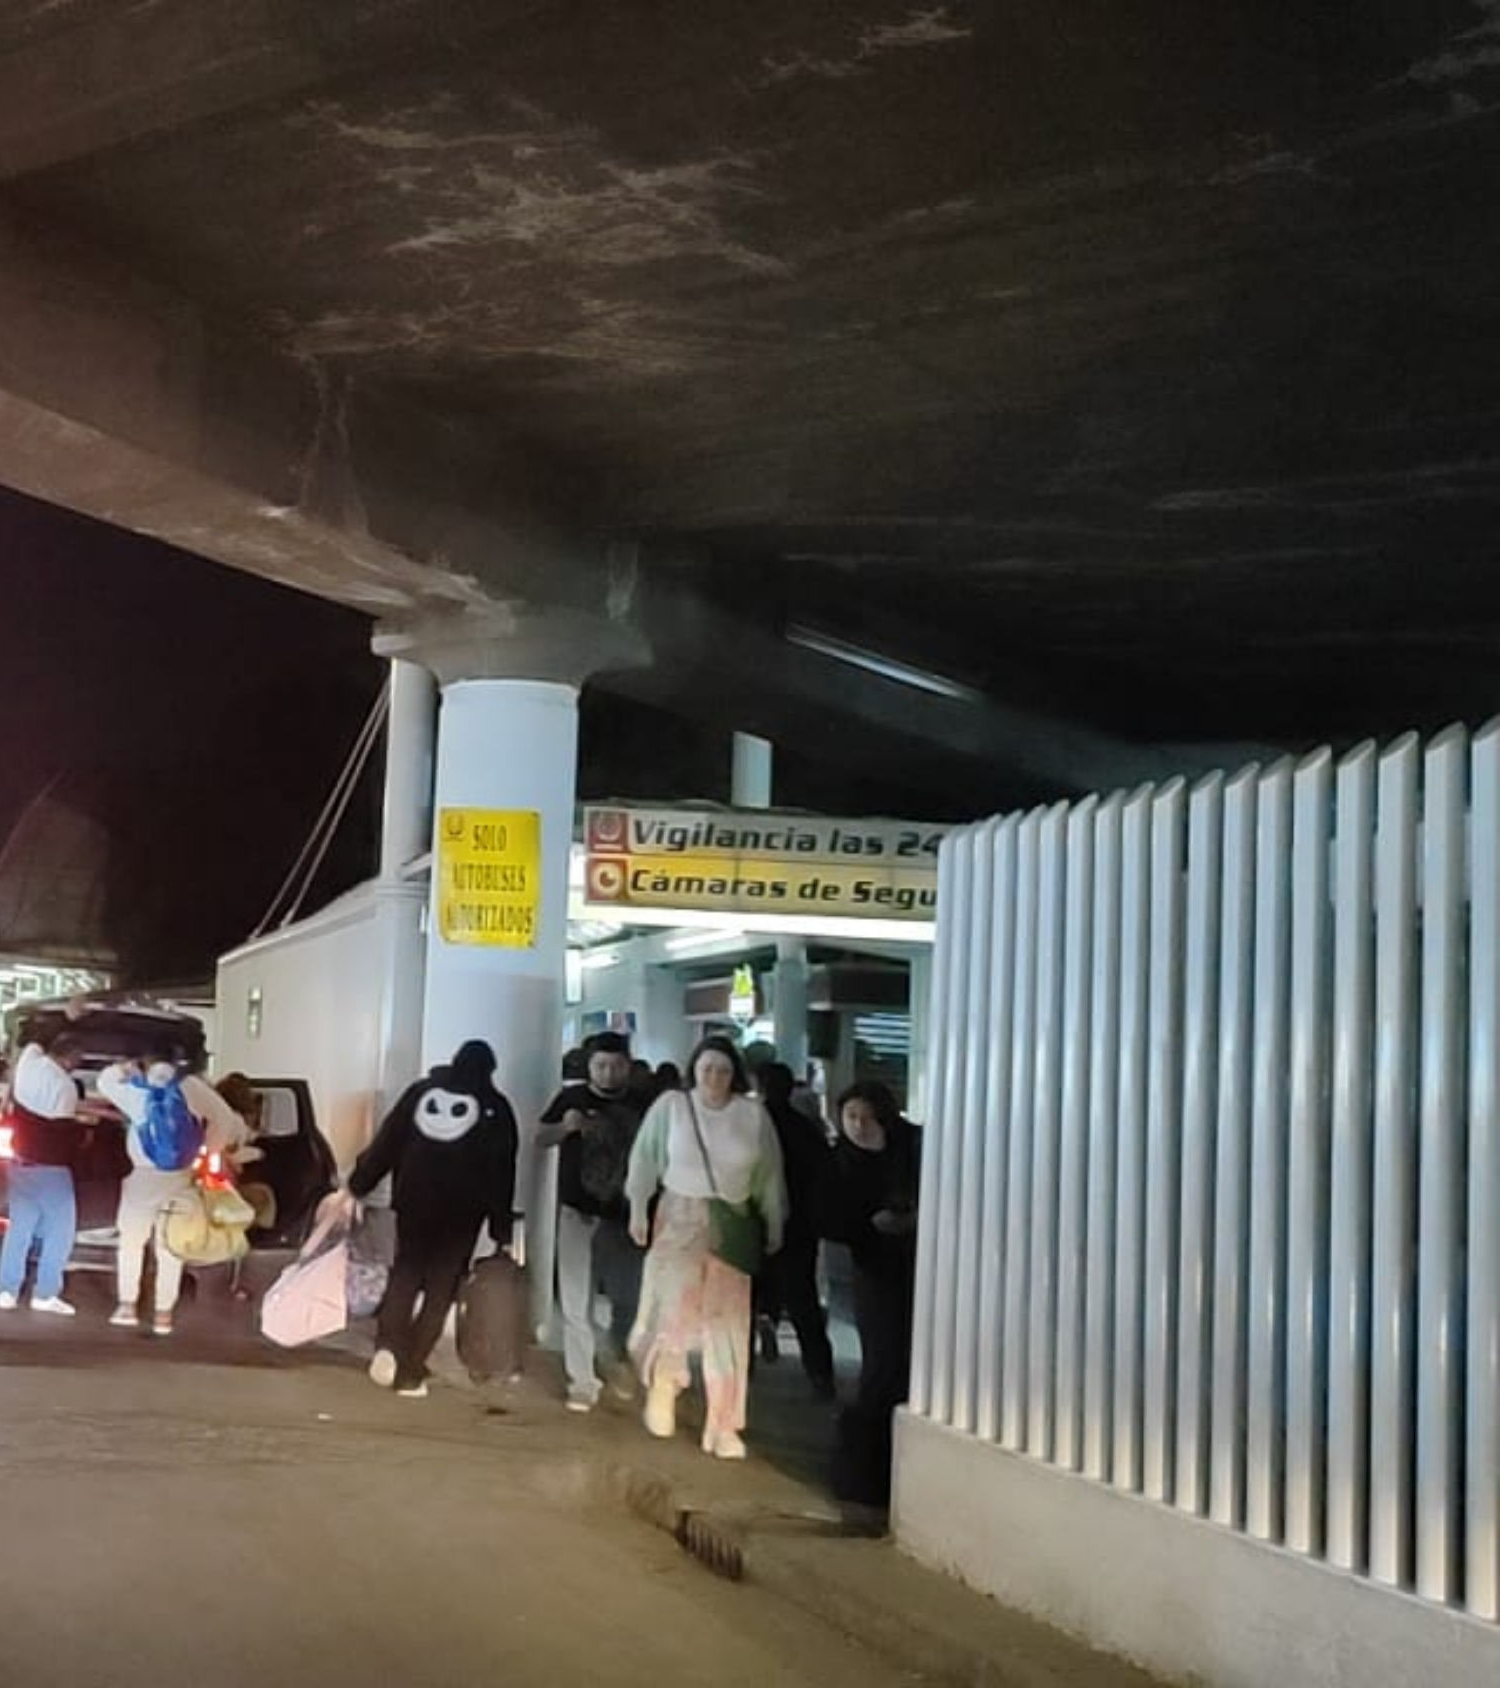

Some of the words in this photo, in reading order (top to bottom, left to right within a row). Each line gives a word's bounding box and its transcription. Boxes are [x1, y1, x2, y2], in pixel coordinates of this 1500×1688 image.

[472, 823, 507, 852] SOLO
[633, 819, 817, 853] Vigilancia
[829, 827, 885, 856] las
[896, 830, 942, 857] 24
[631, 868, 788, 898] Cámaras
[798, 877, 841, 901] de
[852, 880, 936, 910] Segu
